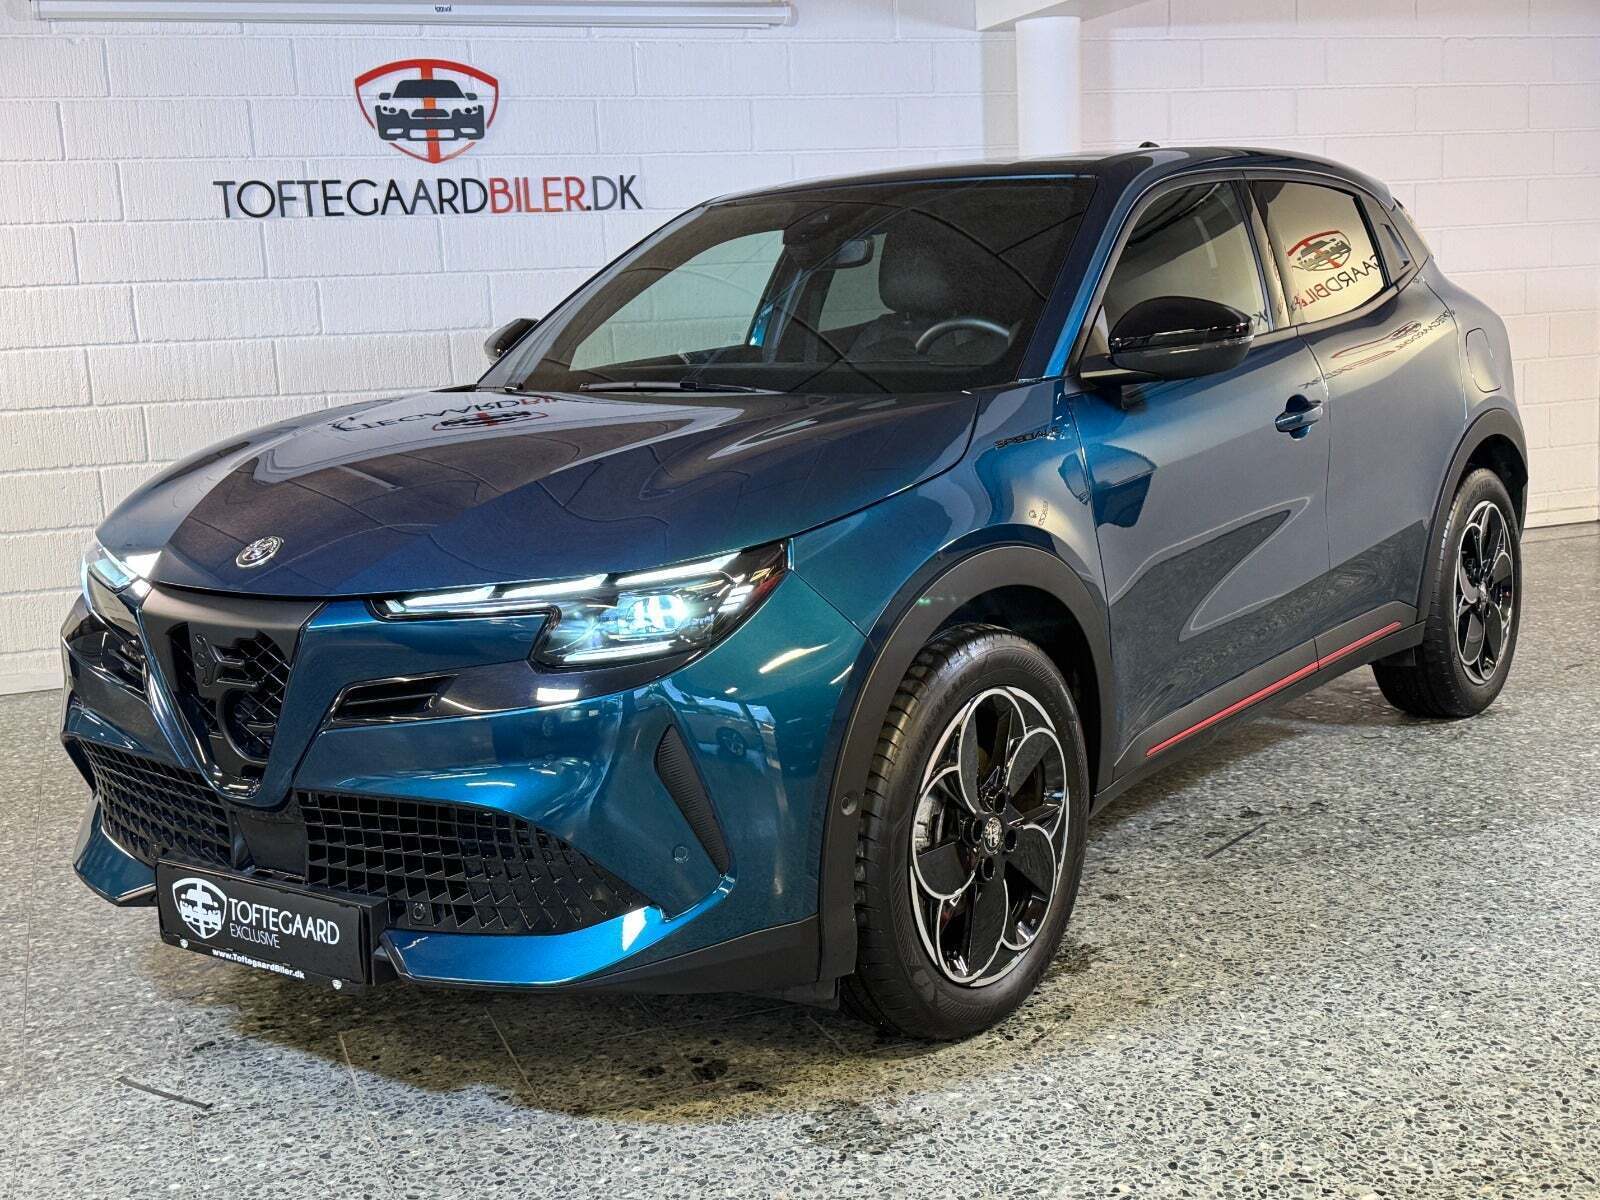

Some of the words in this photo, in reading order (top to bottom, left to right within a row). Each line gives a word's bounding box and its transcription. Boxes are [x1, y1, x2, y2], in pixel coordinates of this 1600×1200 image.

[213, 174, 643, 218] TOFTEGAARDBILER.DK
[228, 897, 340, 945] TOFTEGAARD
[229, 923, 281, 949] EXCLUSIVE
[212, 948, 305, 980] www.ToftegaardBiler.dk
